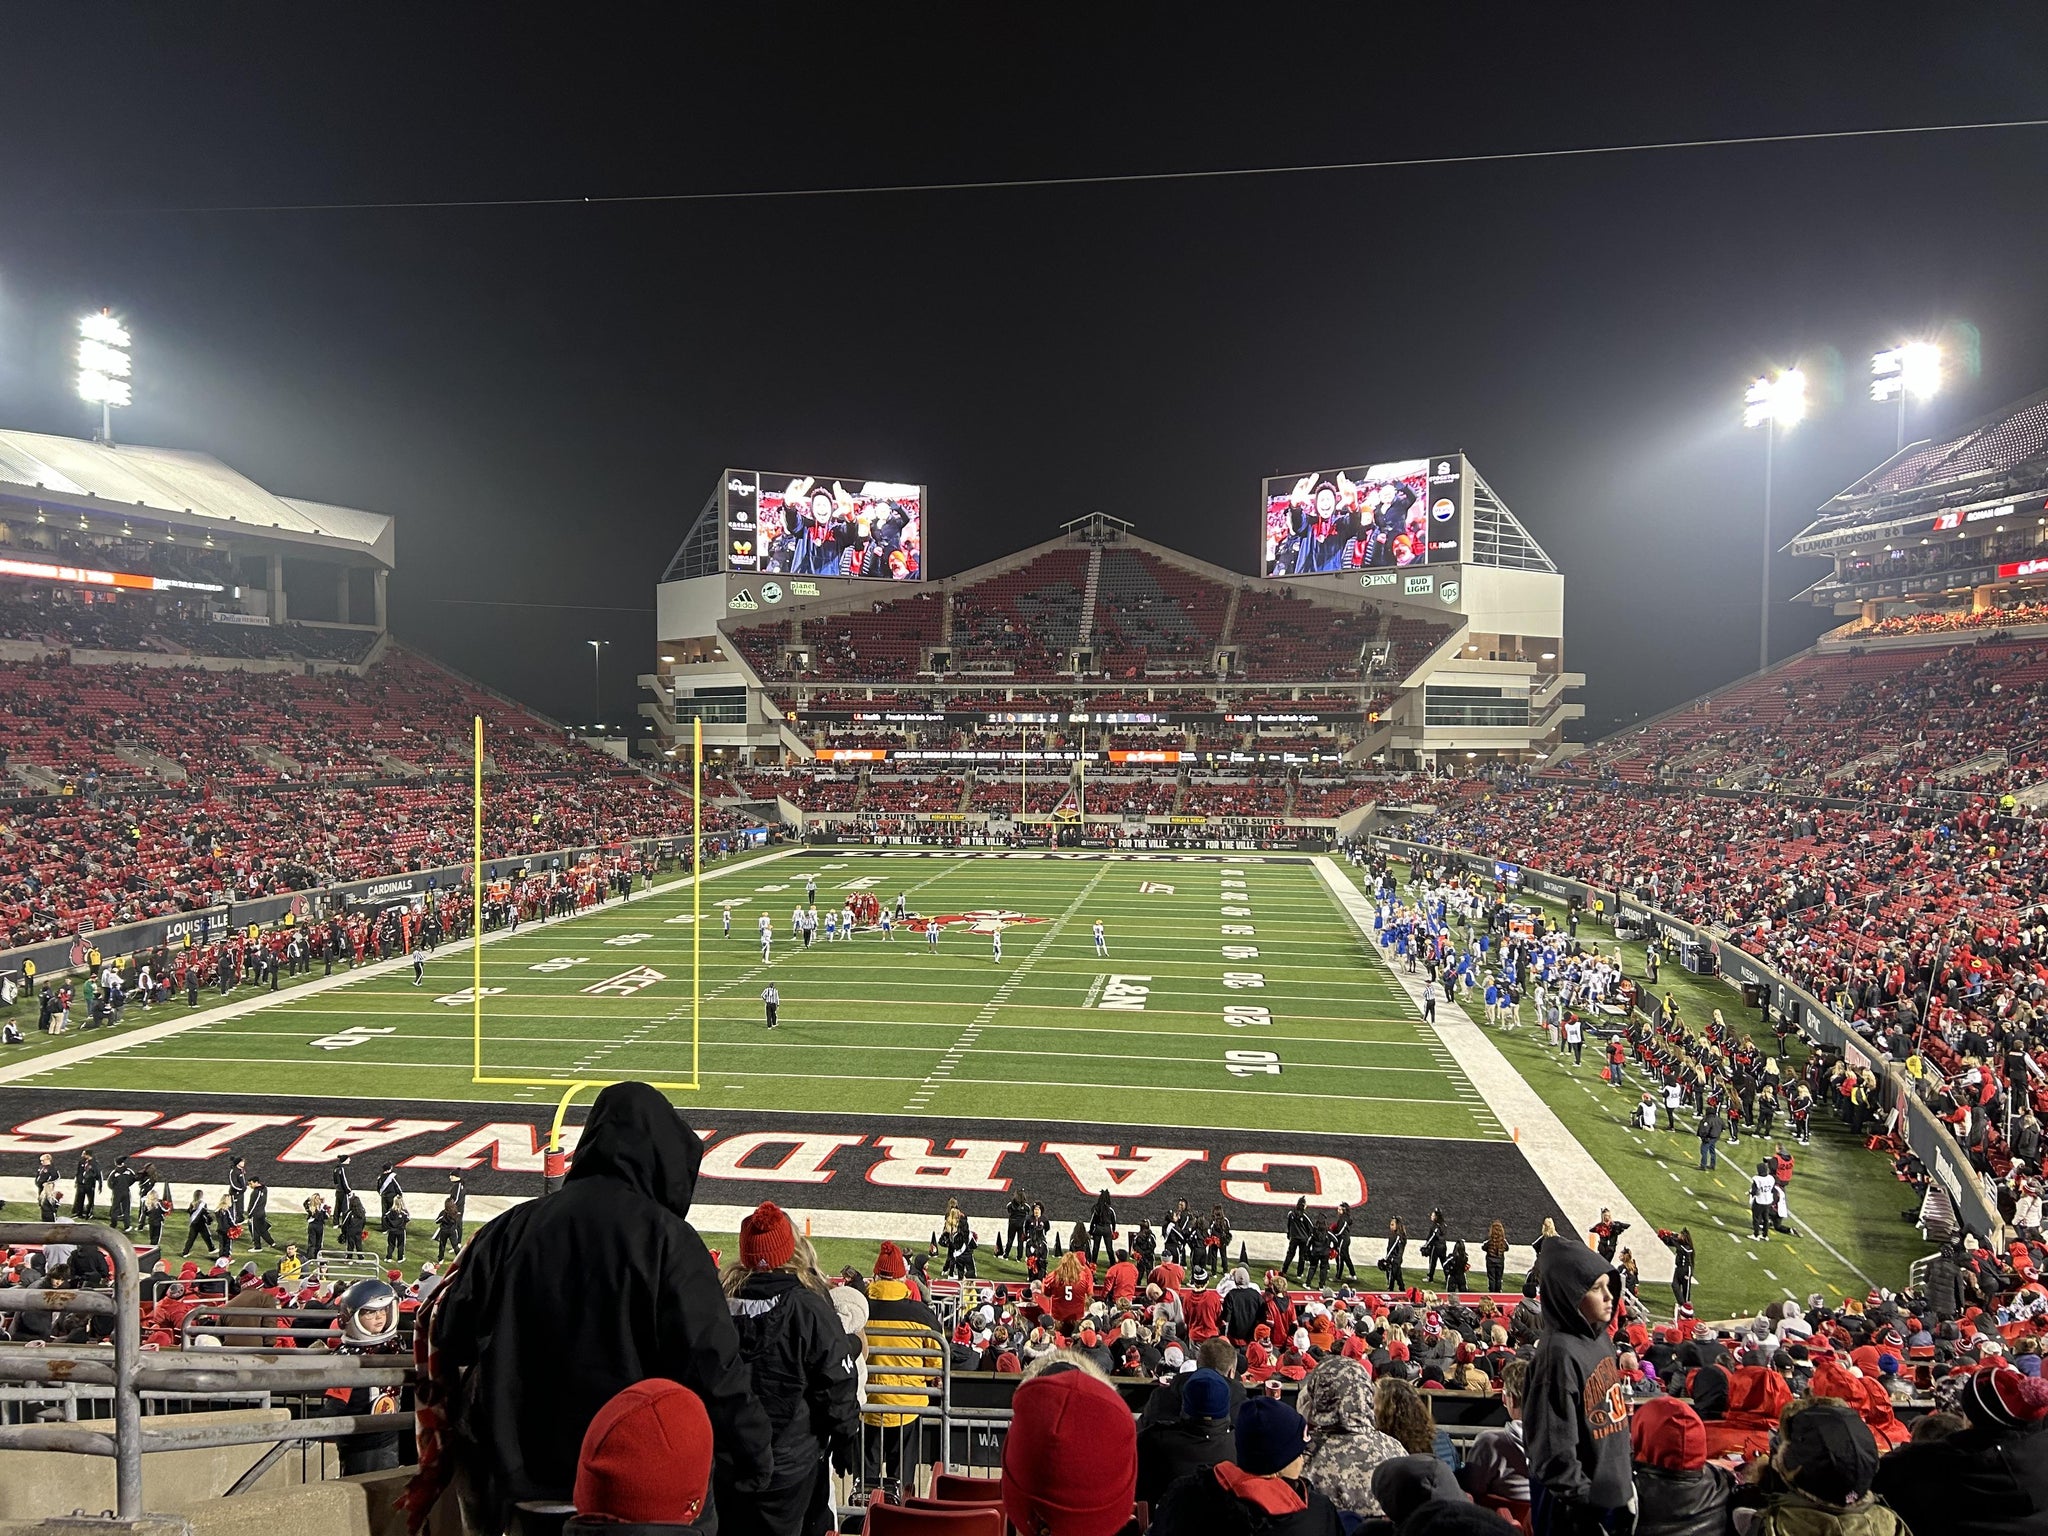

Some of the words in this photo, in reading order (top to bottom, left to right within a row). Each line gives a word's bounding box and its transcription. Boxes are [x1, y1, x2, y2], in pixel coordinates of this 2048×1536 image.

[1802, 539, 1833, 552] LAMAR
[1835, 530, 1877, 548] JACKSON
[1884, 527, 1891, 538] 8
[791, 582, 815, 591] planet
[1373, 574, 1396, 585] PNC
[1410, 578, 1428, 586] BUD
[1407, 585, 1431, 593] LIGHT
[1442, 588, 1457, 600] ups
[729, 600, 757, 609] adidas
[925, 714, 944, 722] Sports
[1298, 715, 1318, 723] Sports
[856, 813, 881, 821] FIELD
[884, 813, 916, 821] SUITES
[1221, 817, 1248, 825] FIELD
[1251, 818, 1285, 826] SUITES
[889, 836, 902, 845] THE
[972, 837, 986, 846] THE
[1118, 838, 1132, 848] FOR
[1134, 839, 1147, 848] THE
[1205, 840, 1220, 849] FOR
[1221, 840, 1235, 849] THE
[367, 879, 413, 896] CARDINALS
[1221, 945, 1260, 960] 40
[528, 956, 591, 974] 30
[1222, 971, 1266, 990] 30
[1740, 965, 1760, 984] NISSAN
[432, 986, 508, 1007] 20
[1098, 974, 1152, 1010] L&N
[1223, 1005, 1274, 1028] 20
[308, 1025, 398, 1051] 10
[1224, 1050, 1282, 1078] 10
[0, 1108, 1369, 1209] CARDNALS
[1064, 1285, 1073, 1301] 5
[978, 1433, 999, 1447] WA
